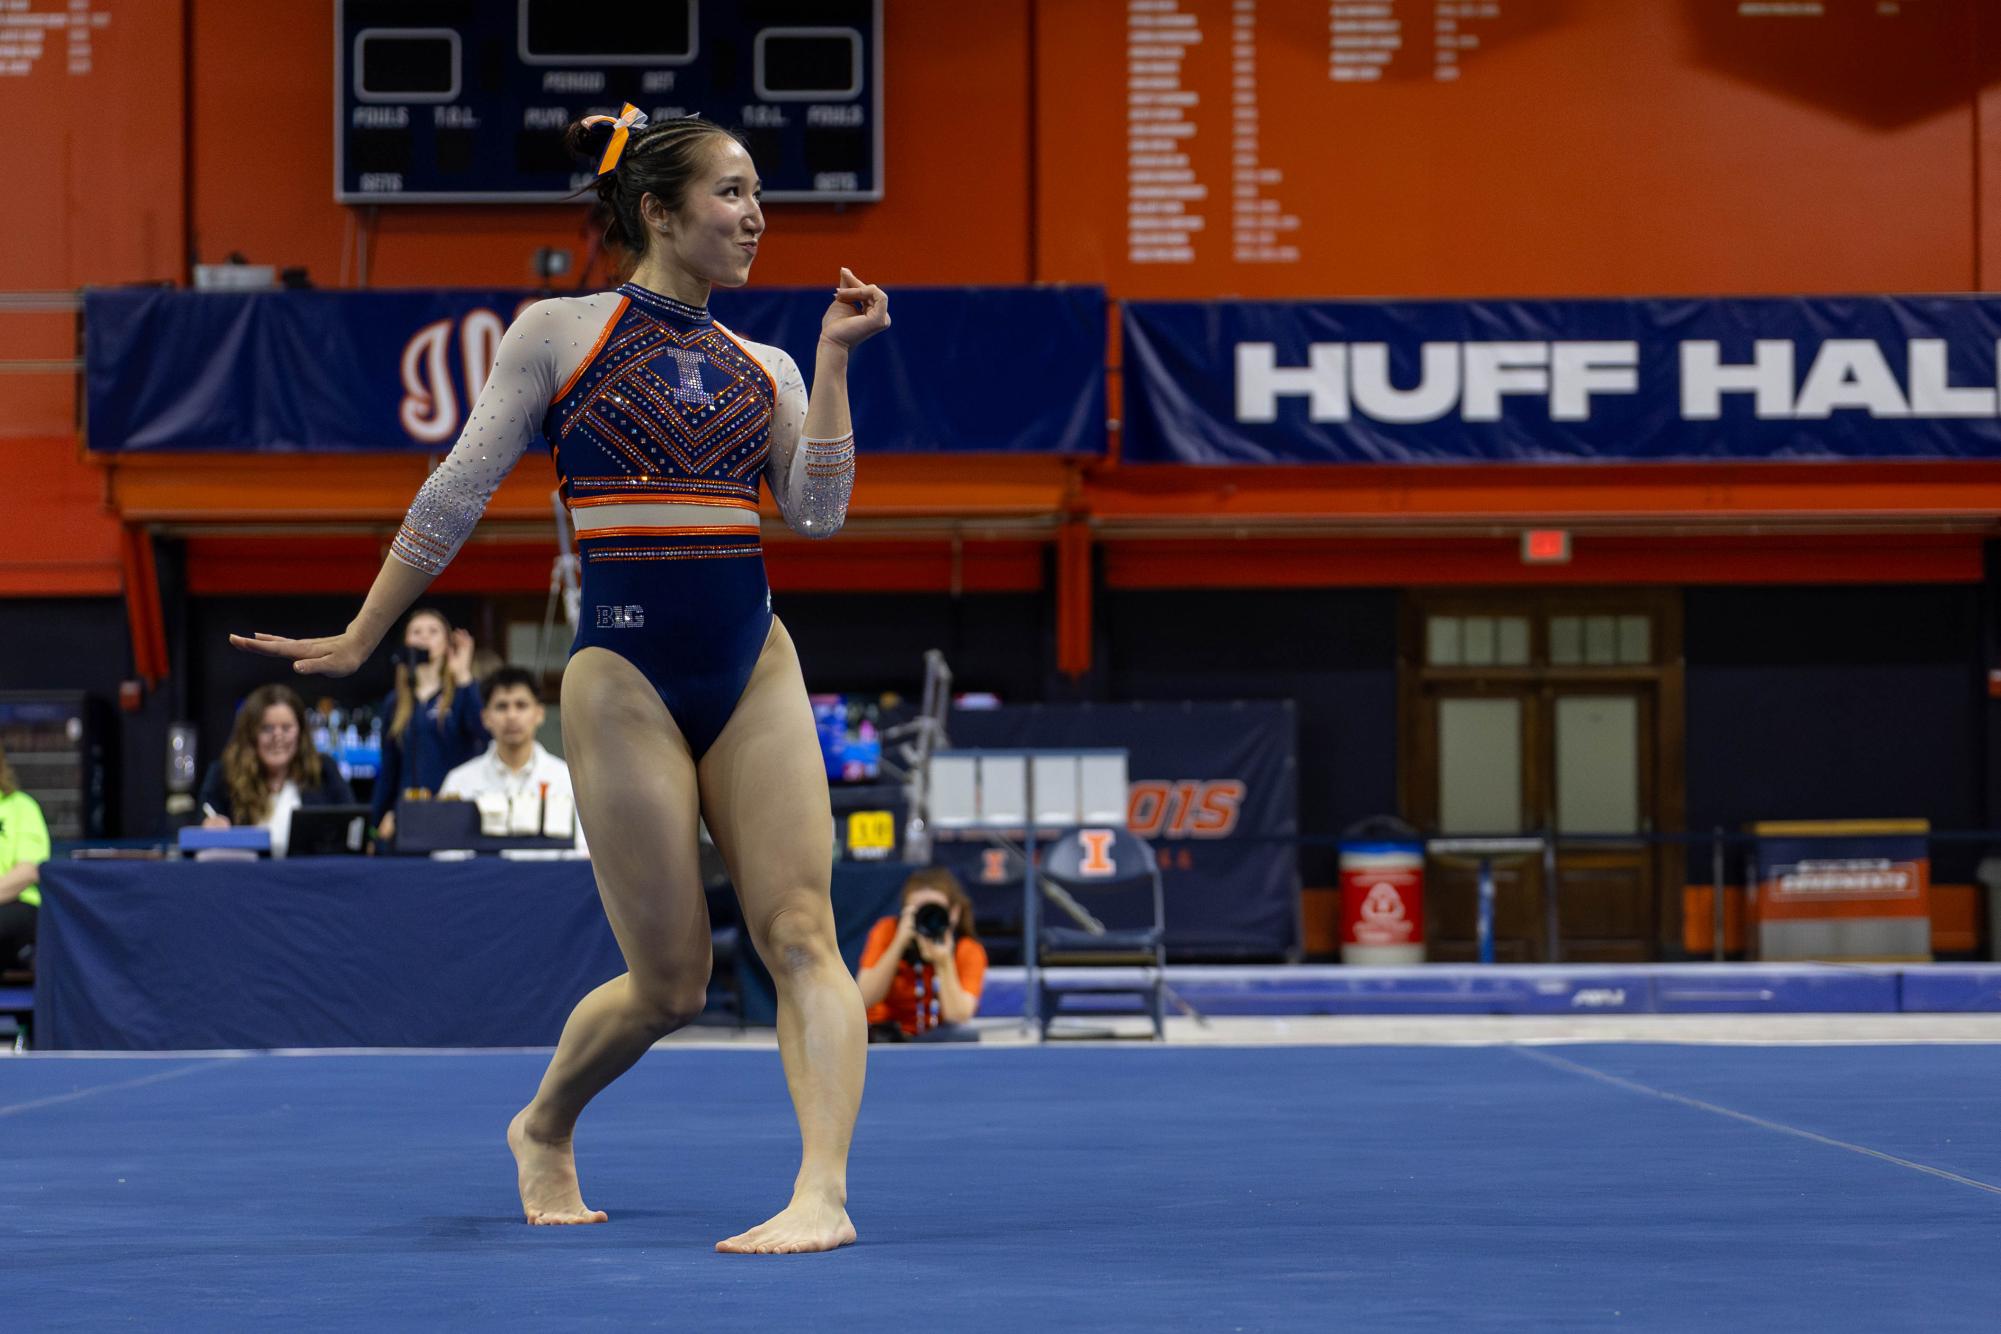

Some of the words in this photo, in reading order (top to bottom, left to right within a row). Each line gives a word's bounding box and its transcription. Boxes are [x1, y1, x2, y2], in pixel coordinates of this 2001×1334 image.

[1235, 341, 1639, 423] HUFF
[1679, 338, 2001, 420] HAL
[1079, 829, 1116, 877] I
